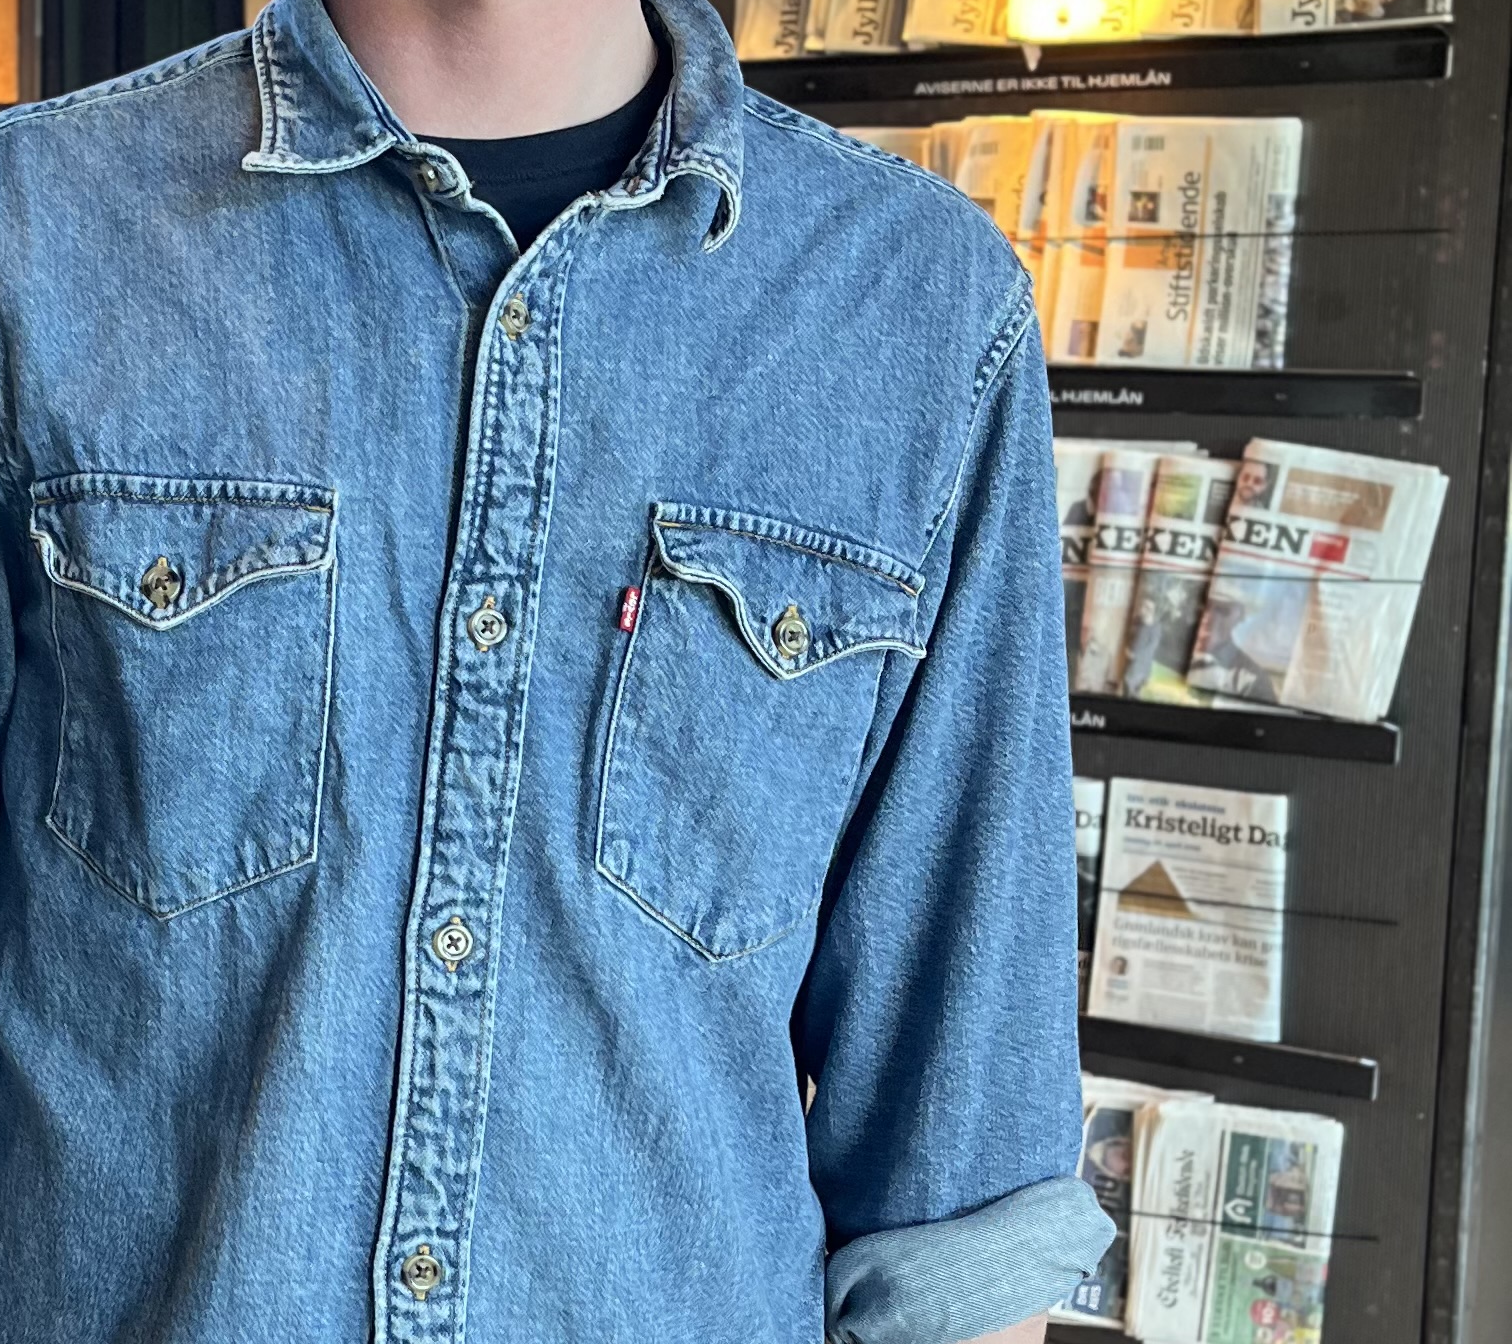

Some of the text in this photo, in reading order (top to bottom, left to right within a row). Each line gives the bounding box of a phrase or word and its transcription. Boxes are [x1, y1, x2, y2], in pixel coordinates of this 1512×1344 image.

[914, 69, 1172, 96] AVISERNE ER IKKE TIL HJEMLÅN
[1166, 171, 1202, 323] Stiftstidende
[1061, 387, 1144, 405] HJEMLÅN
[1124, 807, 1243, 846] Kristeligt
